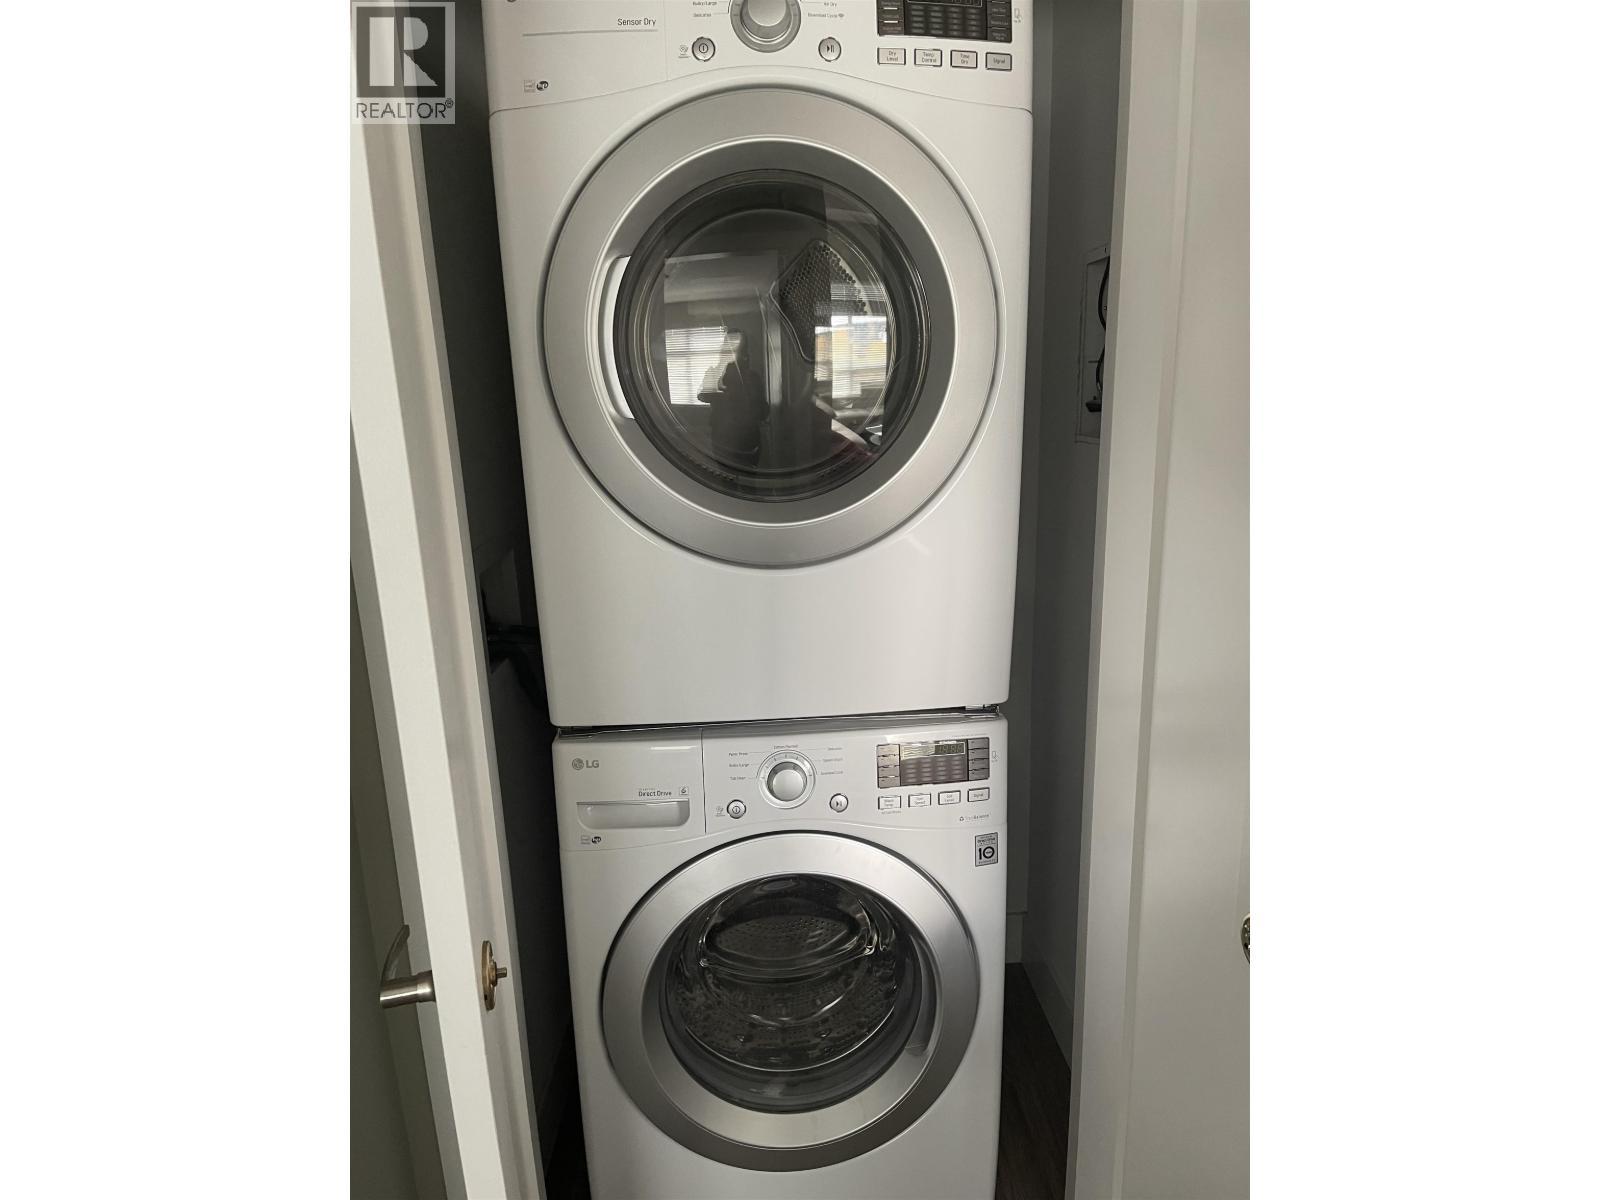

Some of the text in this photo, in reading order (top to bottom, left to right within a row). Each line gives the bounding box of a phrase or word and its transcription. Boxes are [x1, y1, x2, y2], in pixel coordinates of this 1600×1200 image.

[617, 17, 657, 27] Sensor Dry
[585, 760, 600, 769] LG
